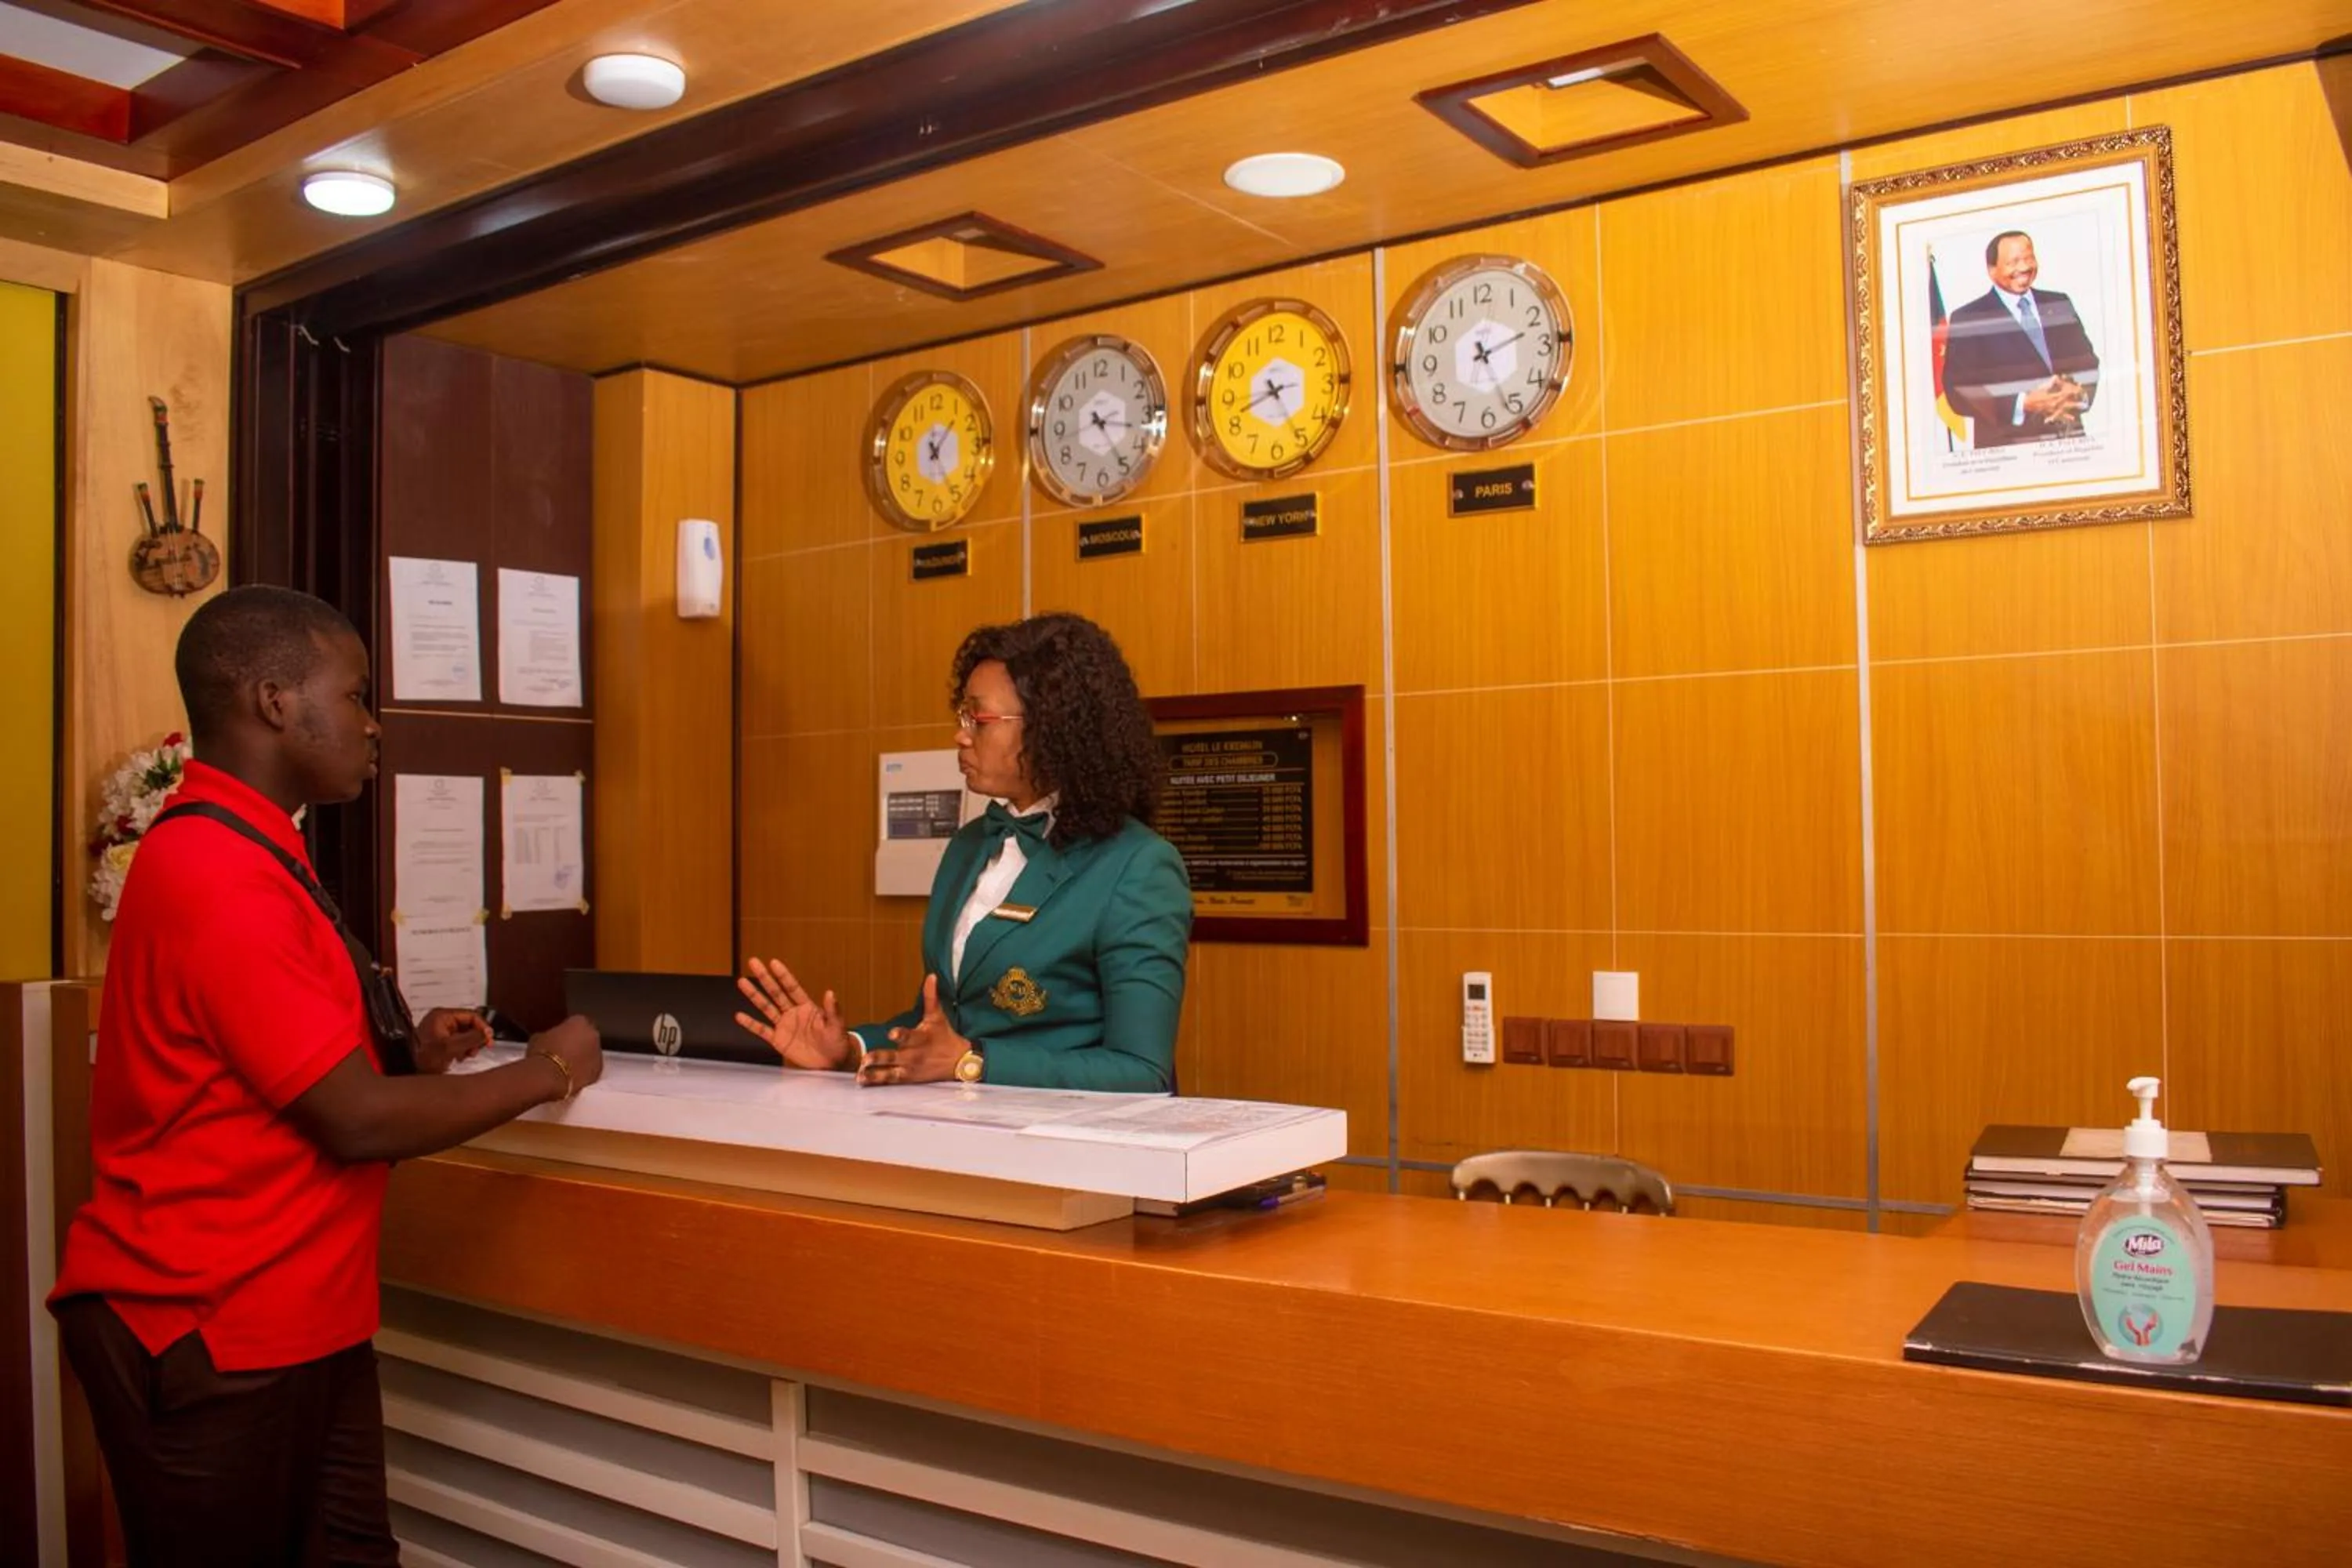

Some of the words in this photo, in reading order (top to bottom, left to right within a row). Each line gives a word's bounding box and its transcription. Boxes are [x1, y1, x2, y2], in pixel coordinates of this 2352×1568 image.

[1473, 283, 1492, 304] 12
[1510, 288, 1514, 308] 1
[1450, 298, 1463, 319] 11
[1526, 305, 1541, 327] 2
[1268, 324, 1284, 344] 12
[1299, 329, 1304, 349] 1
[1428, 325, 1447, 344] 10
[1247, 336, 1259, 357] 11
[1537, 333, 1552, 356] 3
[1313, 347, 1326, 368] 2
[1423, 354, 1437, 377] 9
[1094, 359, 1108, 378] 12
[1120, 364, 1125, 382] 1
[1228, 361, 1244, 379] 10
[1526, 367, 1544, 388] 4
[1075, 371, 1086, 390] 11
[1134, 379, 1145, 400] 2
[1322, 373, 1334, 394] 3
[930, 394, 943, 411] 12
[1058, 394, 1073, 411] 10
[1222, 389, 1235, 410] 9
[1432, 383, 1446, 405] 8
[1505, 393, 1523, 415] 5
[913, 405, 924, 423] 11
[954, 398, 958, 415] 1
[1142, 405, 1152, 424] 3
[1312, 404, 1327, 424] 4
[1453, 401, 1465, 423] 7
[965, 413, 977, 431] 2
[1229, 416, 1241, 436] 8
[1481, 406, 1496, 429] 6
[1054, 421, 1065, 440] 9
[1294, 427, 1308, 448] 5
[971, 436, 981, 456] 3
[1132, 435, 1145, 453] 4
[1247, 434, 1258, 455] 7
[1271, 440, 1284, 461] 6
[1061, 445, 1072, 465] 8
[964, 466, 976, 481] 4
[1076, 462, 1087, 481] 7
[1118, 456, 1131, 476] 5
[901, 474, 911, 492] 8
[1097, 466, 1109, 488] 6
[915, 488, 924, 508] 7
[949, 484, 962, 503] 5
[1475, 481, 1513, 499] PARIS
[656, 1013, 678, 1055] hp
[2128, 1236, 2161, 1253] Mila
[2113, 1260, 2135, 1272] Gel
[2137, 1262, 2172, 1276] Mains
